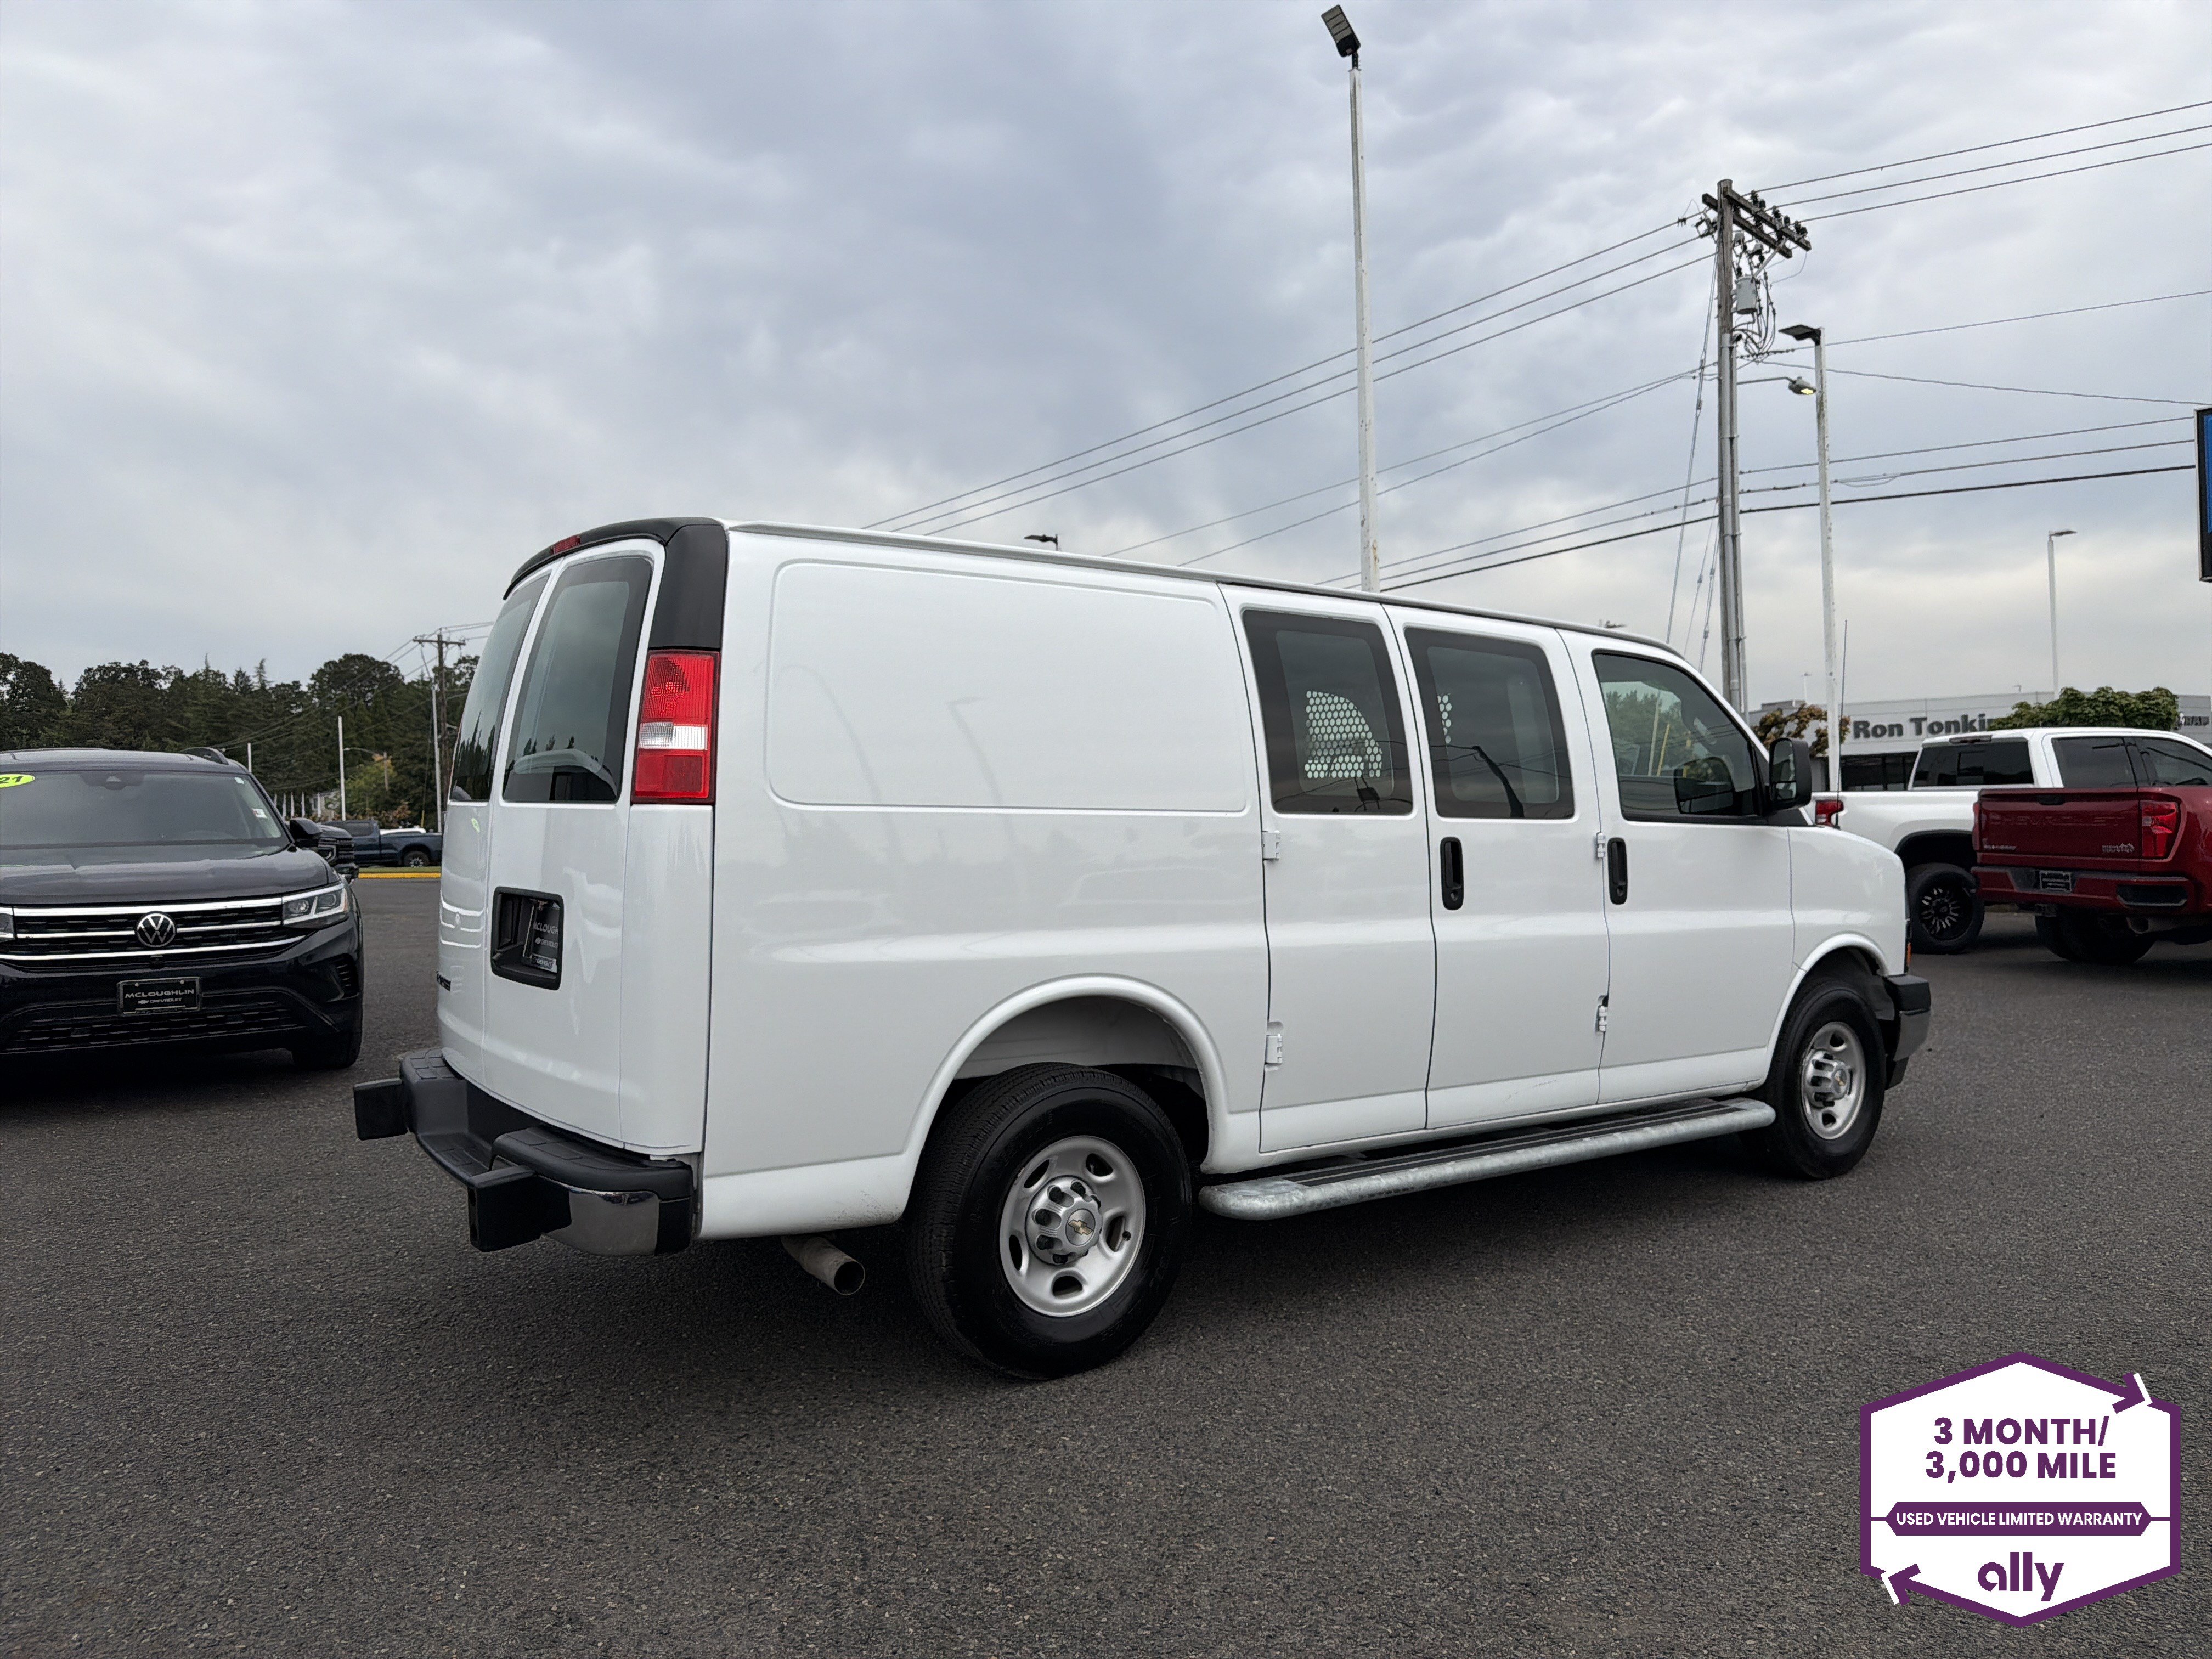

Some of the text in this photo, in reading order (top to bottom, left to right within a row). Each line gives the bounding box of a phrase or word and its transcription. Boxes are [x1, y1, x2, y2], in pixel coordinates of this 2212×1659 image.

[1853, 713, 1993, 739] Ron Tonki
[125, 989, 194, 998] MCLOUGHLIN
